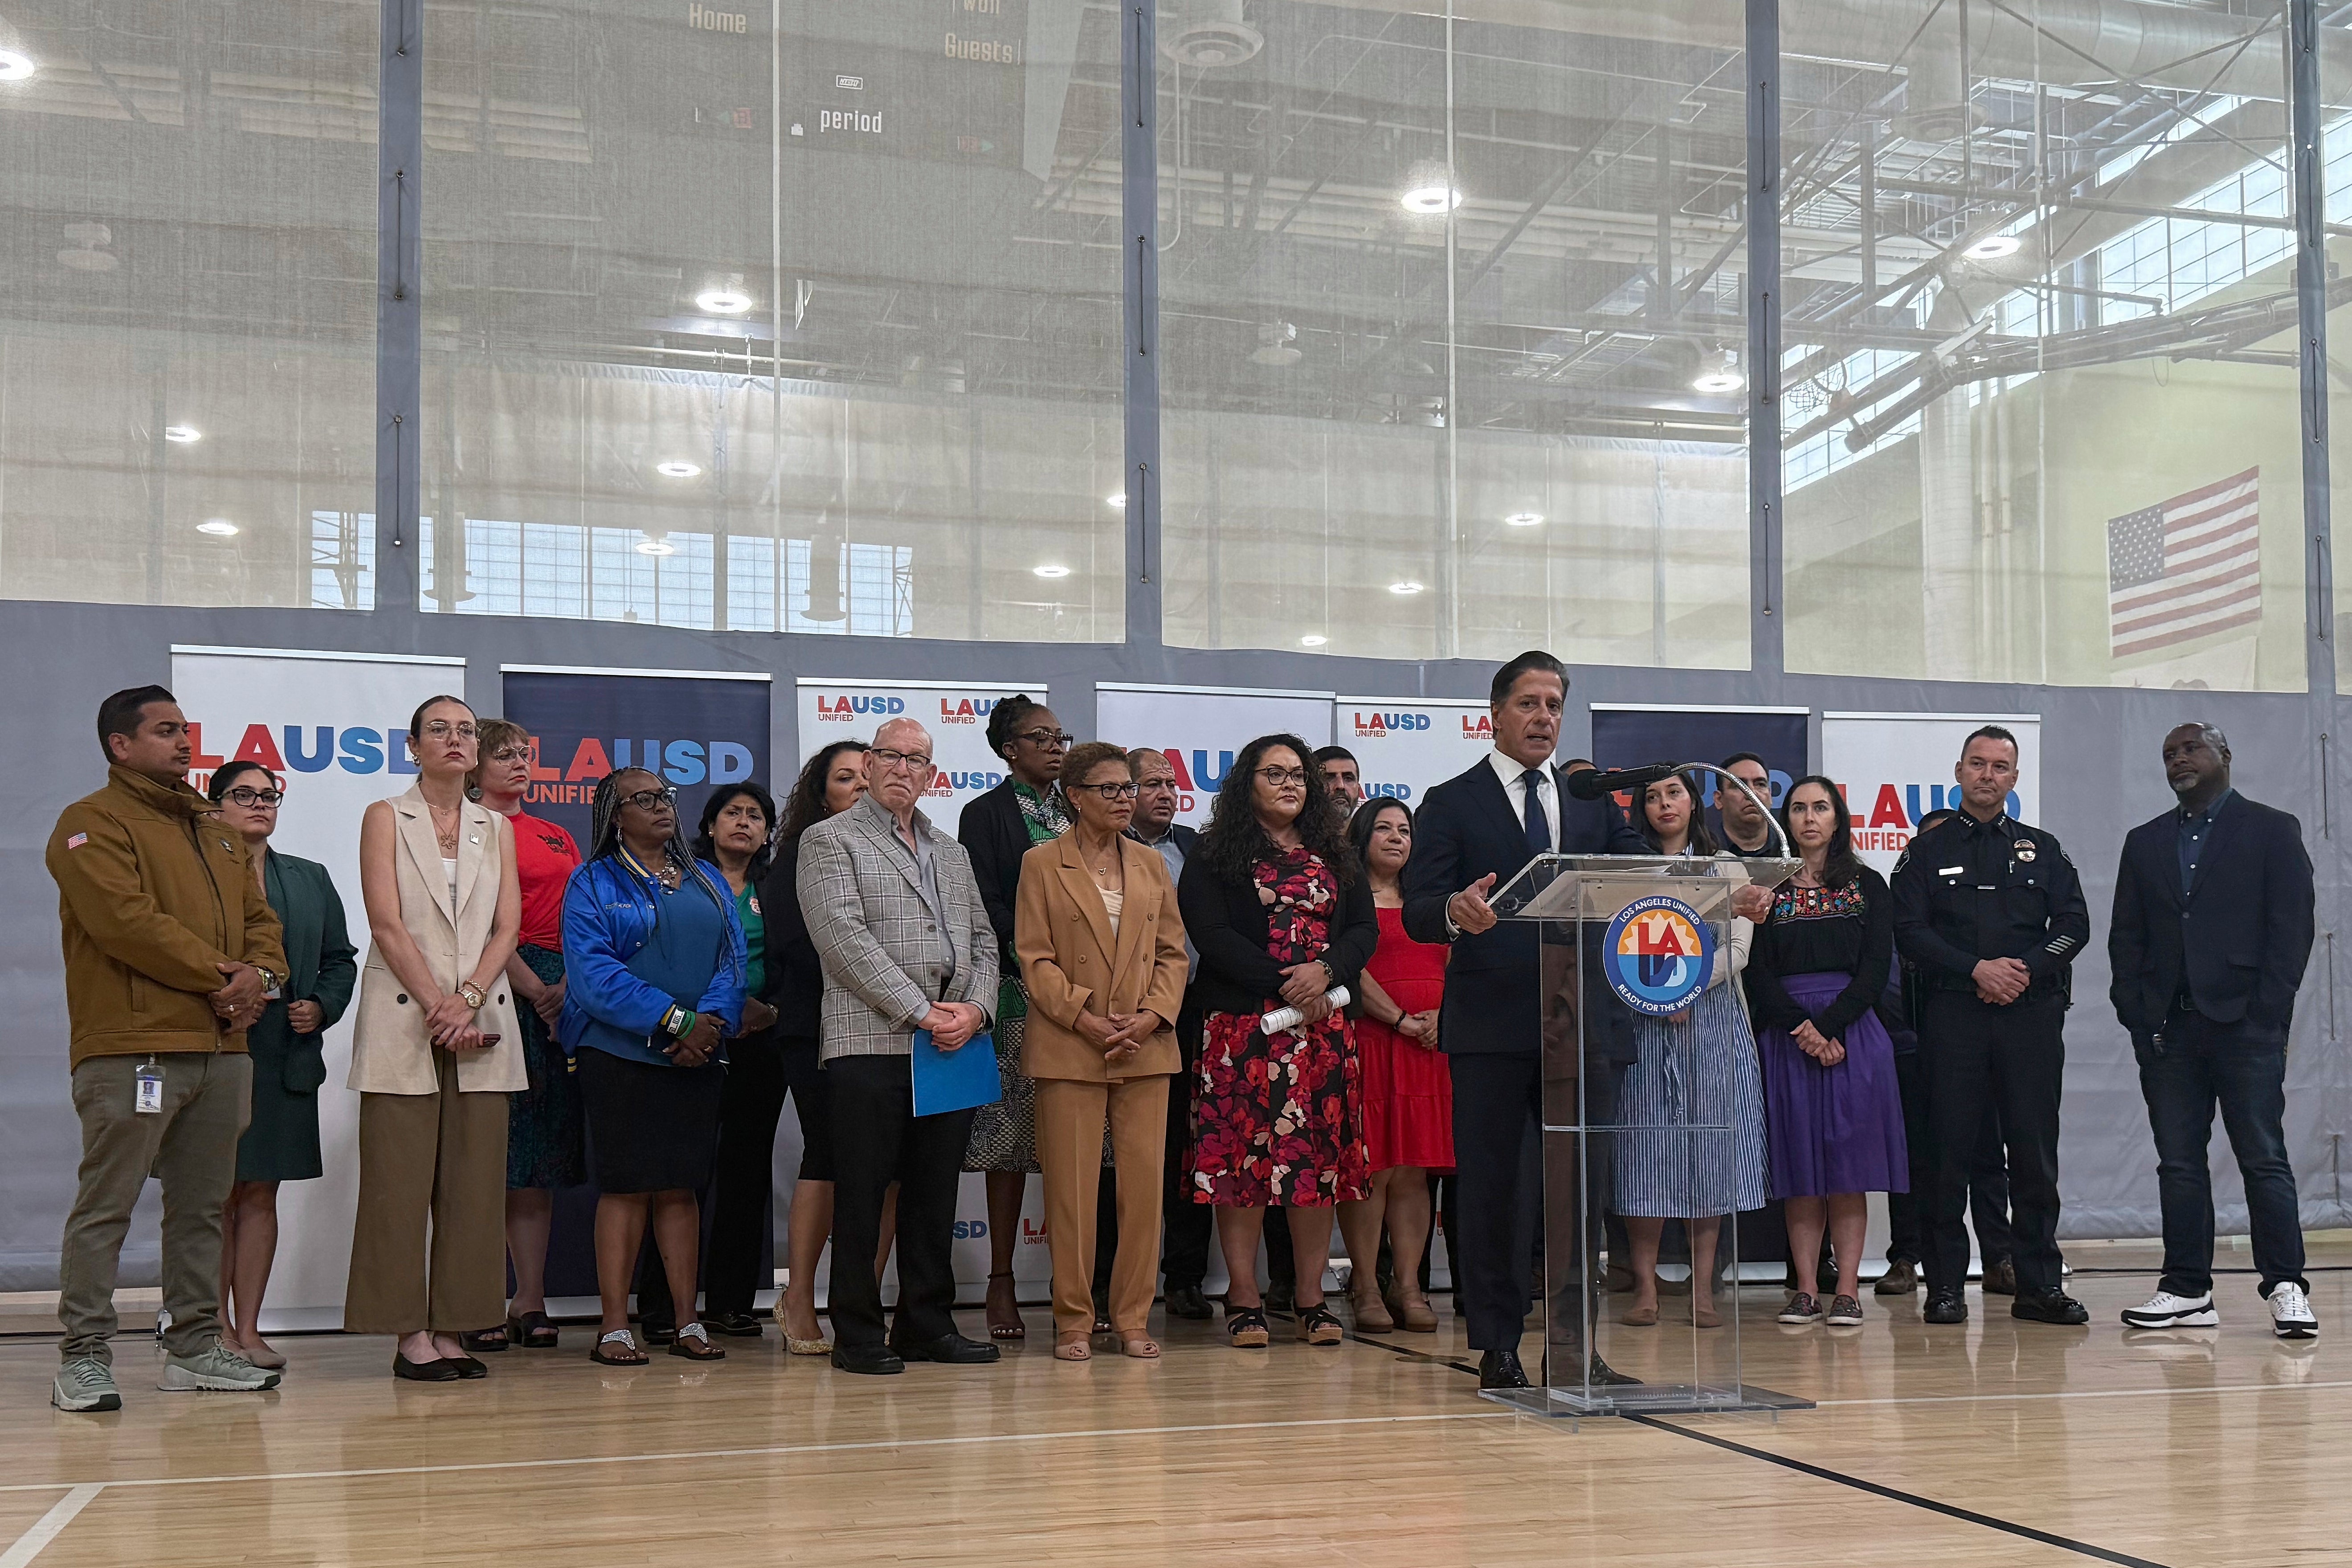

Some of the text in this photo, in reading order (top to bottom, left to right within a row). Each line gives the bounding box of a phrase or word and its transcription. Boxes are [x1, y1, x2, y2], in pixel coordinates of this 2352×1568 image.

[689, 3, 747, 34] Home
[944, 33, 1013, 64] Guests
[821, 110, 882, 134] period
[818, 695, 905, 714] LAUSD
[941, 698, 1000, 716] LAU
[818, 714, 853, 722] UNIFIED
[1355, 713, 1430, 730] LAUSD
[934, 772, 1002, 789] AUSD
[523, 784, 598, 804] UNIFIE
[1850, 832, 1910, 851] NIFIED
[1619, 898, 1700, 925] LOS ANGELES UNIFIED
[1618, 984, 1702, 1012] READY FOR THE WORLD
[1024, 1236, 1049, 1245] UNIFI
